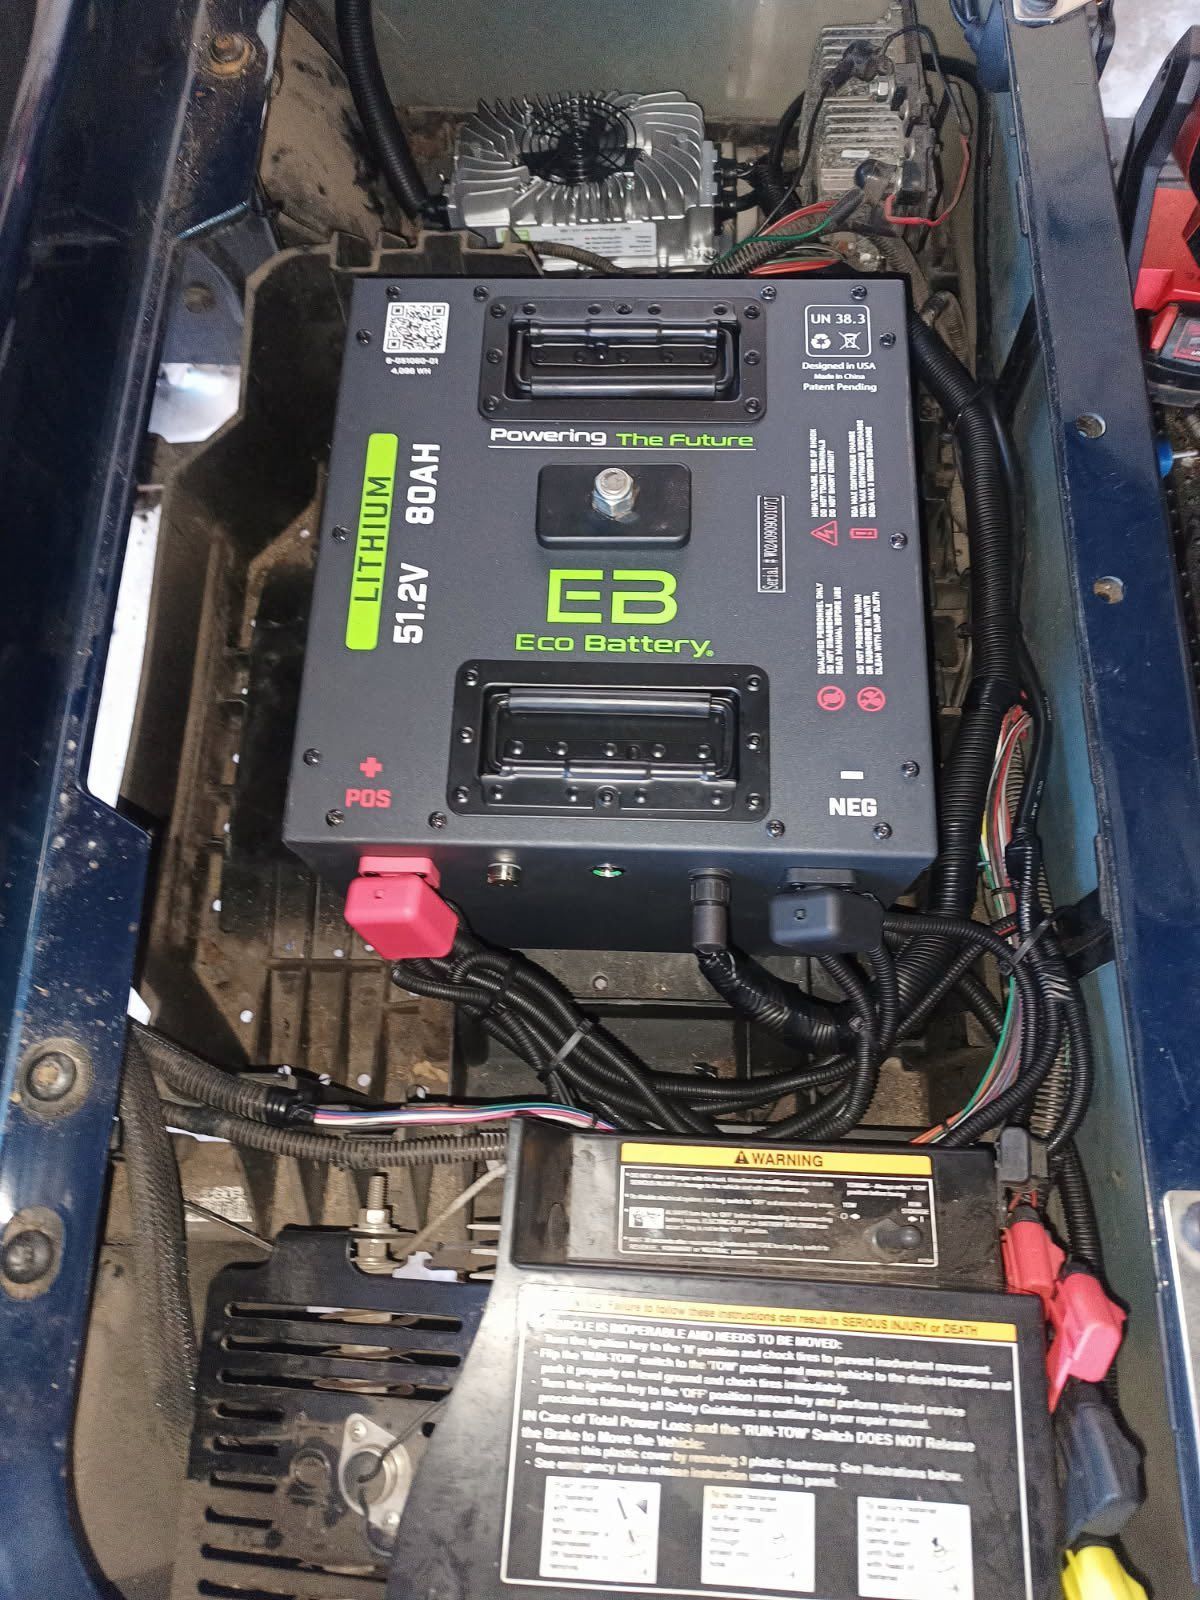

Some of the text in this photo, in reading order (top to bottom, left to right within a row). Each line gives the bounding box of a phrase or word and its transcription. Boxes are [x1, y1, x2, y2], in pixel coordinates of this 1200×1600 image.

[811, 314, 865, 324] UN 38.3
[802, 362, 845, 371] Designed
[837, 383, 877, 392] Pending
[490, 428, 754, 447] Powering The Future
[828, 495, 836, 507] NOT
[820, 509, 827, 517] DO
[829, 509, 836, 517] DO
[355, 475, 391, 602] LITHIUM
[393, 443, 441, 644] 51.2V 80AH
[762, 567, 778, 589] Serial
[546, 570, 677, 624] EB
[515, 635, 577, 651] Eco
[874, 634, 882, 651] WITH
[826, 650, 834, 663] NOT
[856, 650, 864, 664] NOT
[826, 665, 834, 674] DO
[857, 665, 864, 674] DO
[345, 789, 391, 808] POS
[829, 798, 878, 817] NEG
[752, 1152, 823, 1168] WARNING
[841, 1316, 887, 1329] SERIOUS
[889, 1320, 927, 1332] INJURY
[944, 1324, 978, 1335] DEATH
[715, 1331, 756, 1344] NEEDS
[758, 1334, 774, 1345] TO
[777, 1335, 793, 1346] BE
[856, 1431, 893, 1446] DOES
[895, 1434, 924, 1448] NOT
